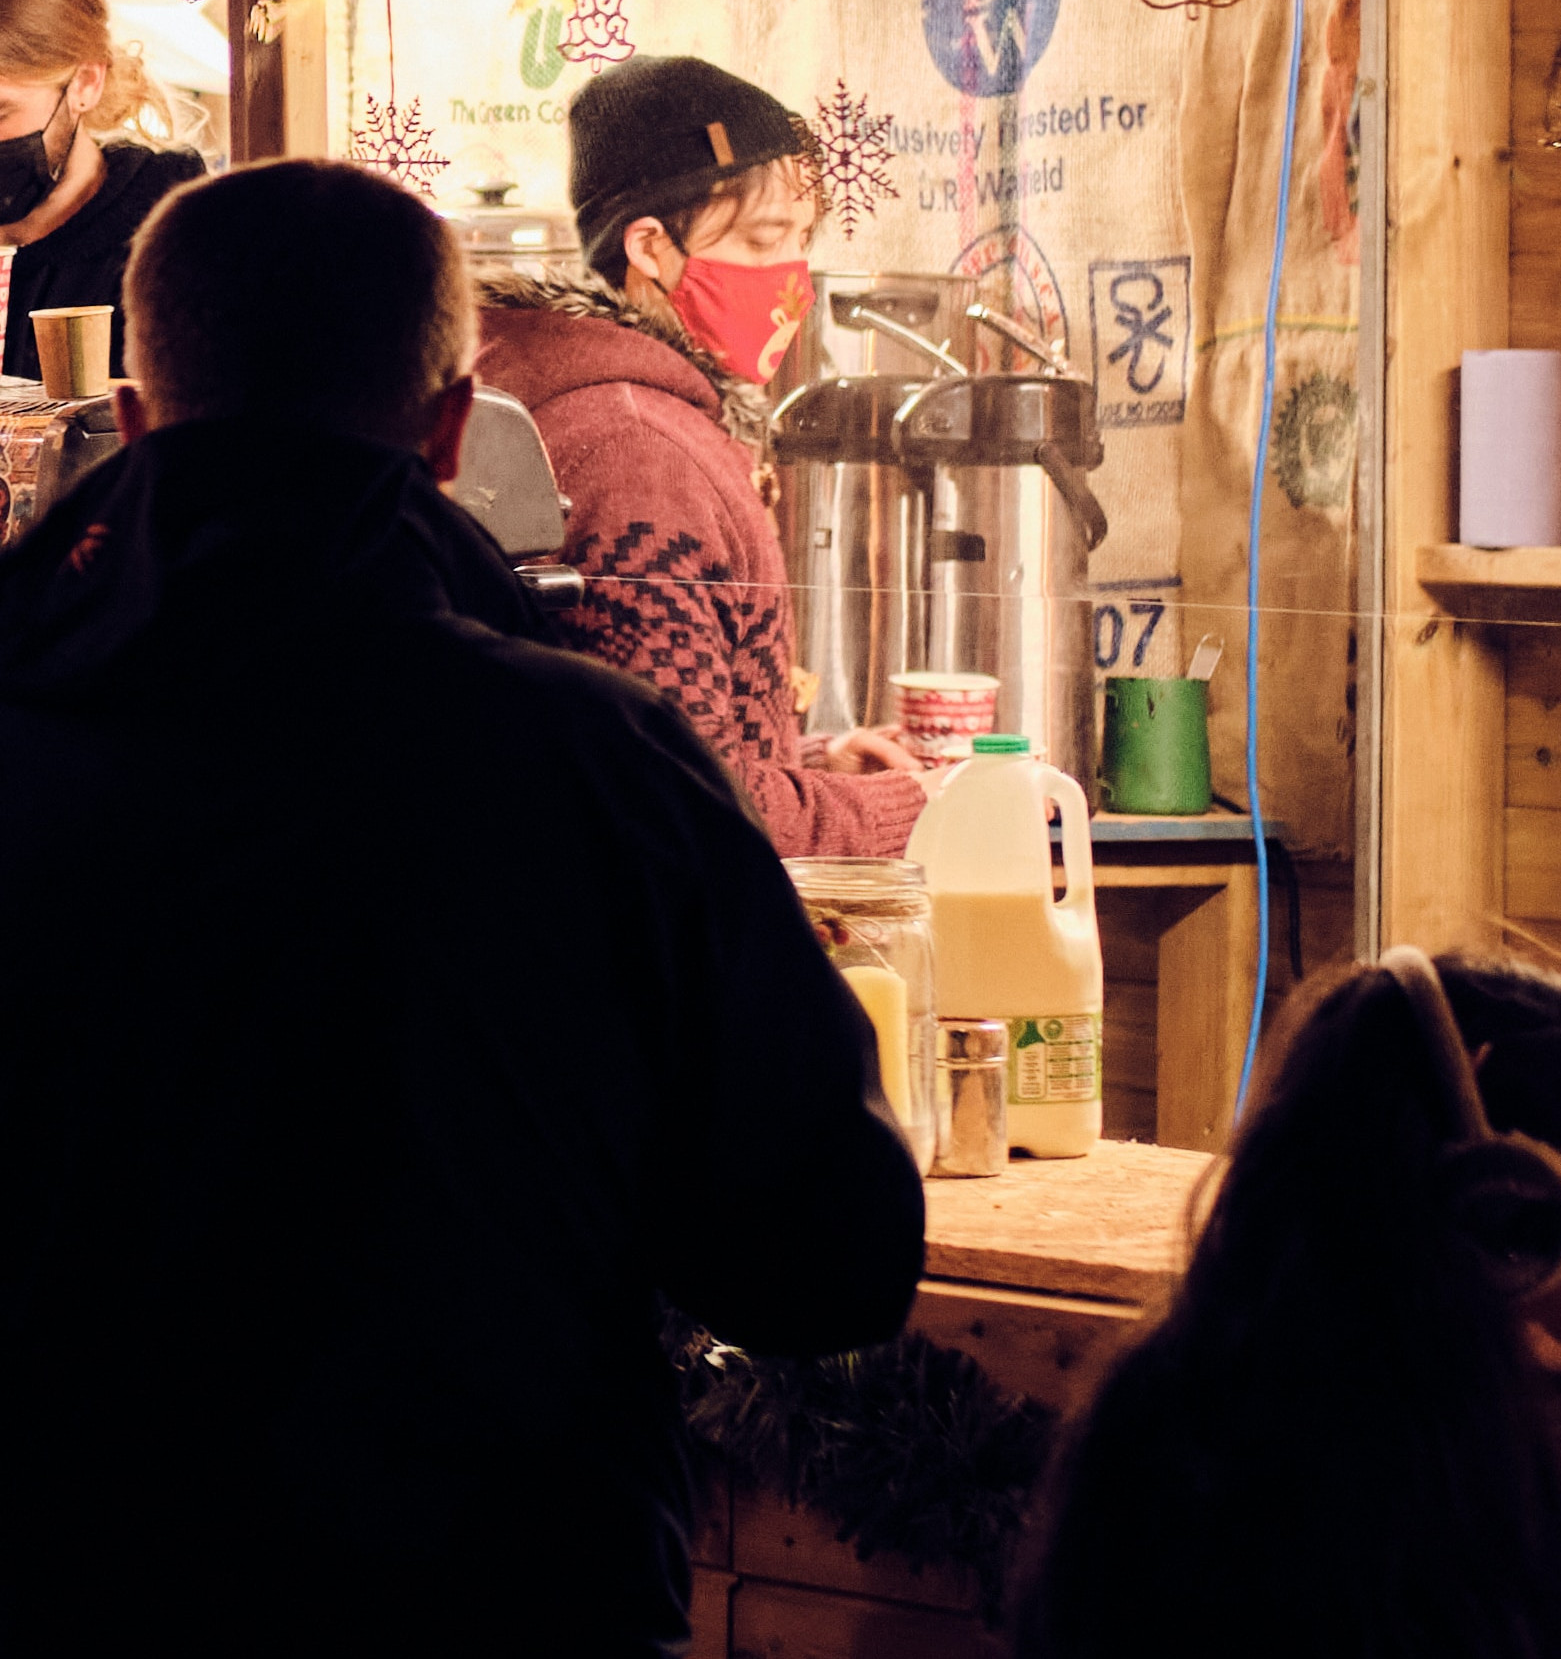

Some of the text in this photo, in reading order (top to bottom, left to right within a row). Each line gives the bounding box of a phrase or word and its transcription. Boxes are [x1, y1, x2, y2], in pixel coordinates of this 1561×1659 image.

[479, 100, 531, 125] Green
[1099, 96, 1148, 131] For
[1093, 597, 1167, 670] 07
